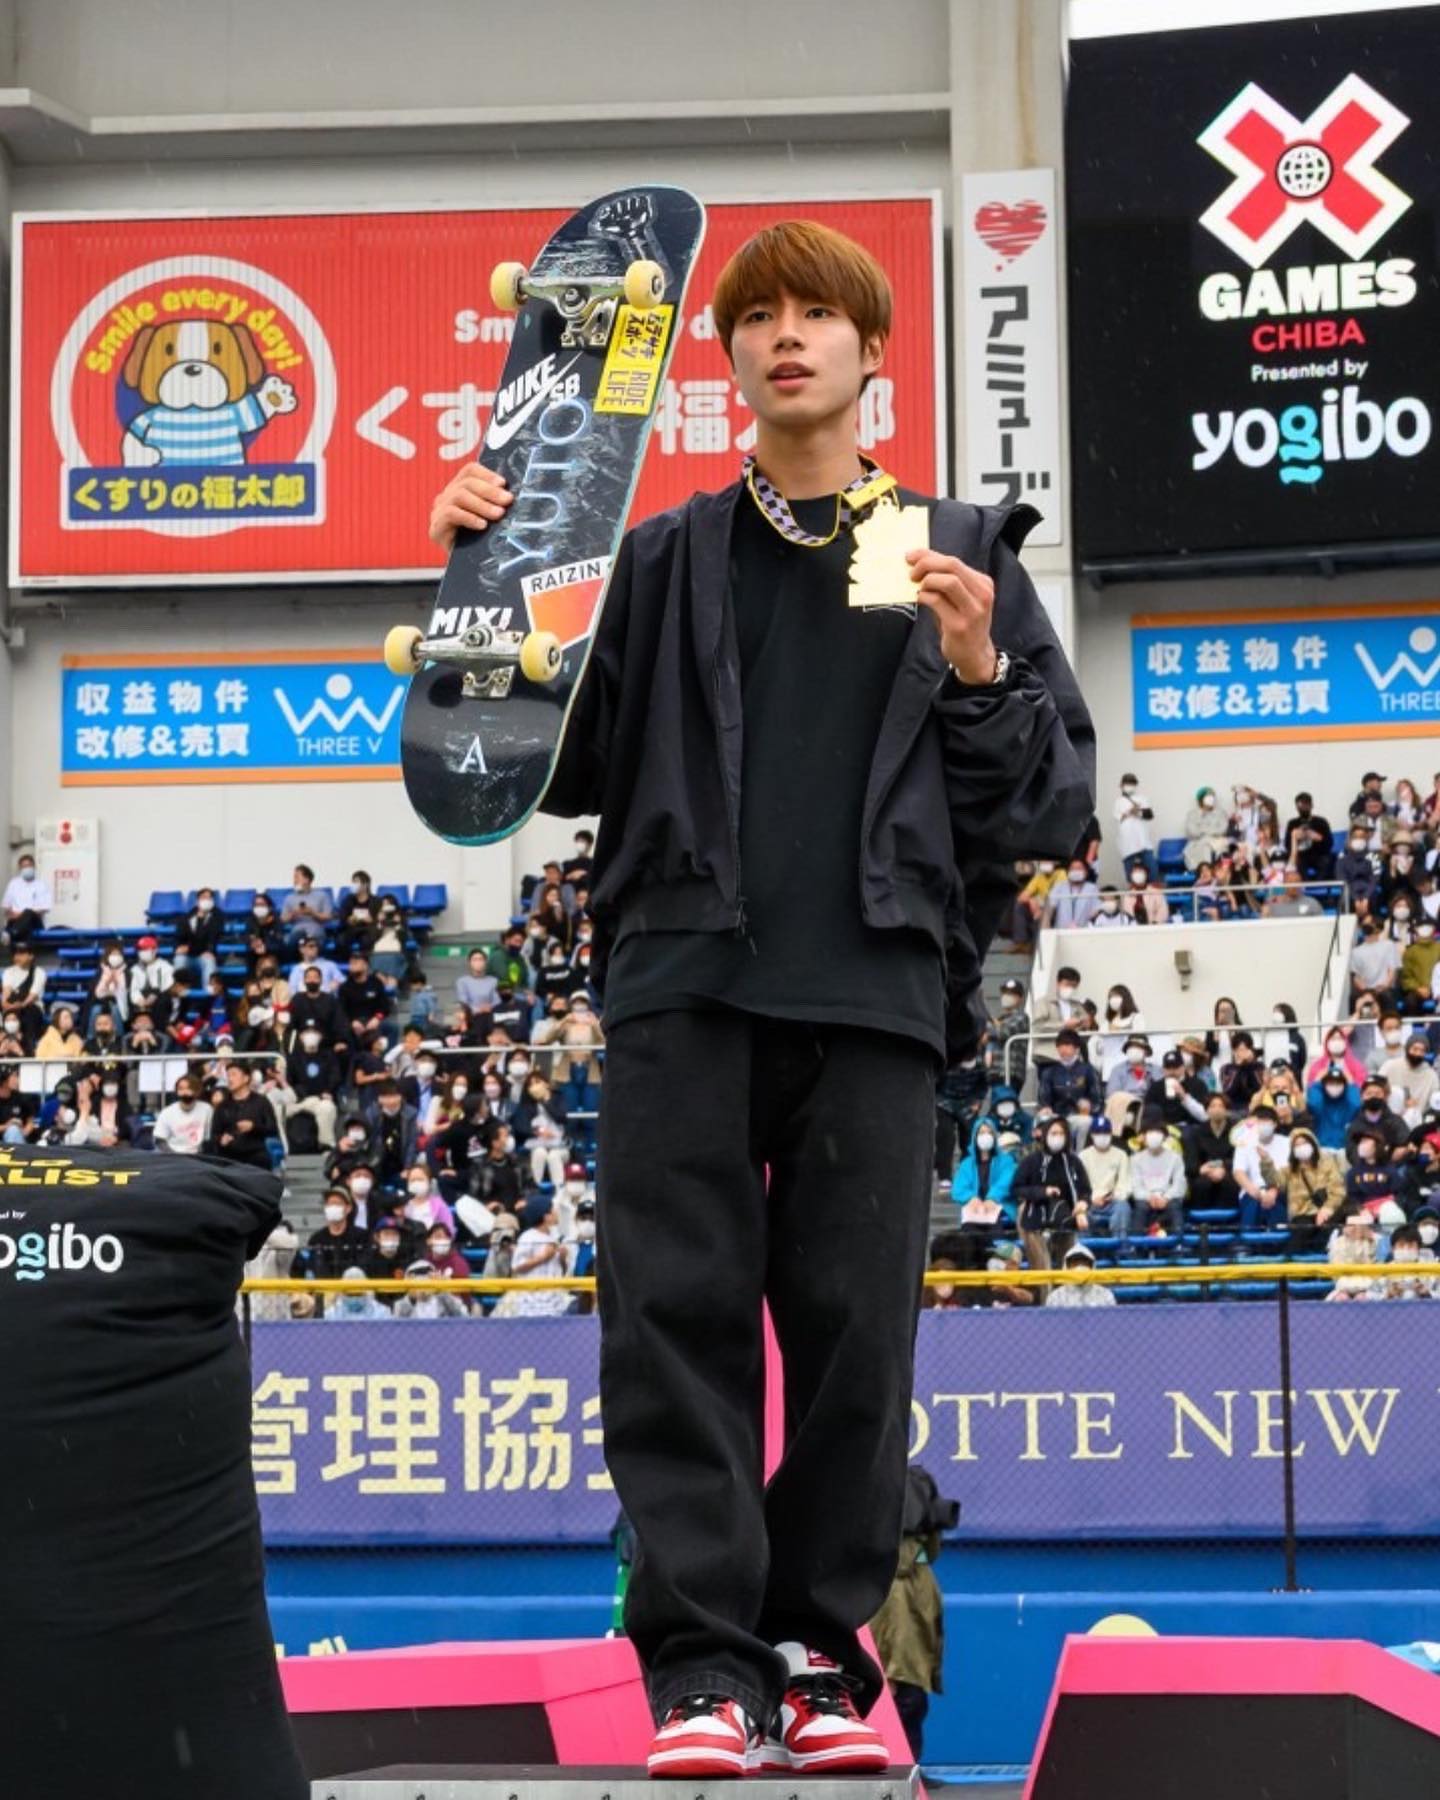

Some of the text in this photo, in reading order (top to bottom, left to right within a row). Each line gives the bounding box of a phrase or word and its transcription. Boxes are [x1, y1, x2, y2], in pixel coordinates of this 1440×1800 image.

[1199, 258, 1417, 321] GAMES
[85, 288, 303, 374] Smile every day!
[1251, 317, 1366, 352] CHIBA
[496, 352, 557, 421] NIKE
[601, 370, 630, 407] LIFE
[1251, 357, 1369, 382] Presented by
[548, 372, 581, 410] SB
[624, 371, 652, 408] RIDE
[1191, 385, 1432, 484] yogibo
[74, 473, 306, 511] くすりの福太郎
[498, 397, 592, 574] YUTO
[531, 561, 601, 593] RAIZIN
[1147, 635, 1328, 676] 収益物件
[75, 678, 250, 716] 収益物件
[1148, 679, 1330, 720] 改修&売買
[75, 723, 250, 759] 改修&売買
[295, 736, 384, 757] THREE V
[458, 735, 489, 774] A
[0, 1168, 142, 1186] LIST
[1164, 1387, 1401, 1459] NEW
